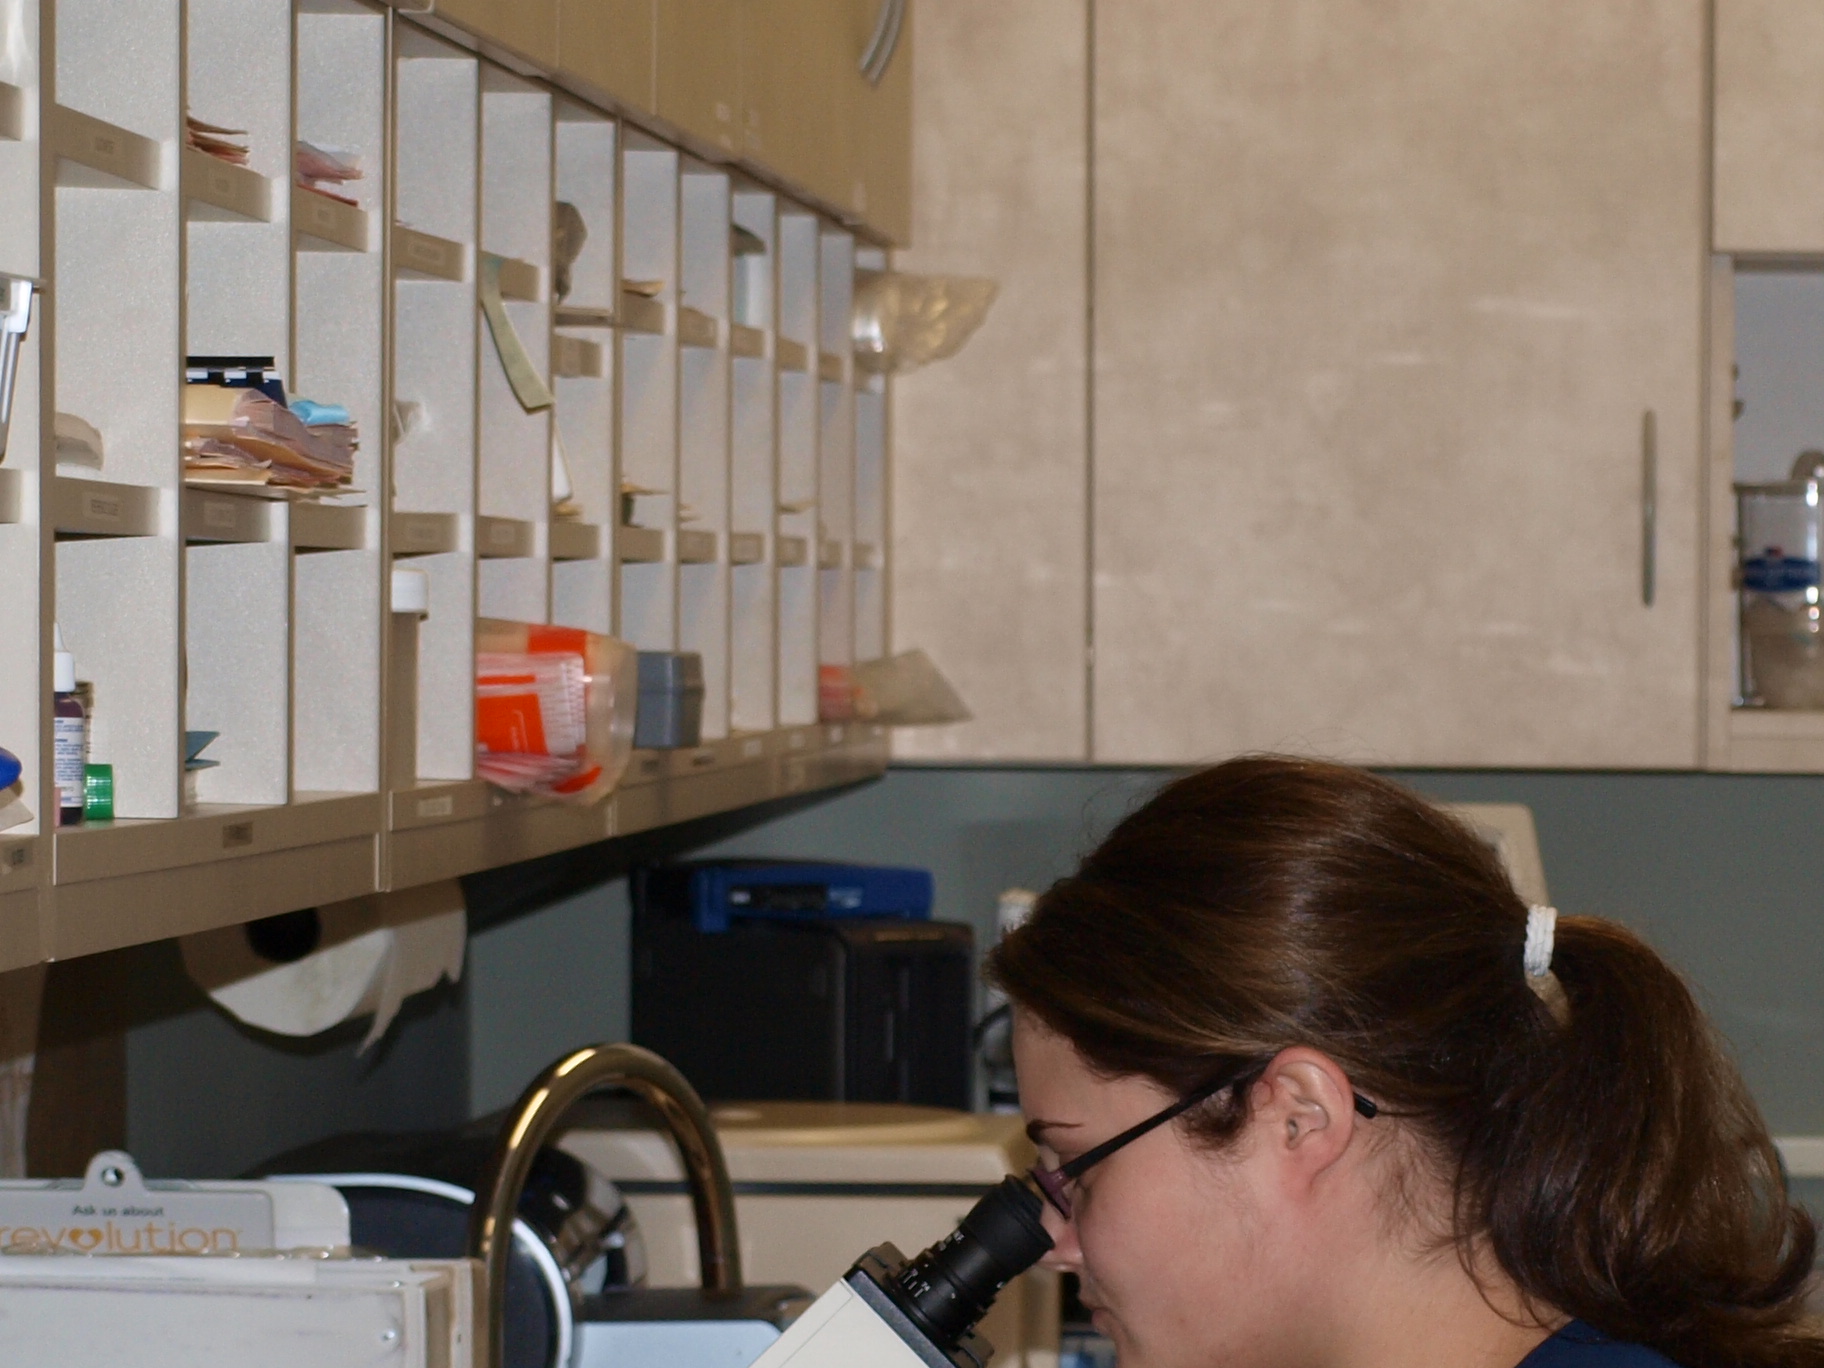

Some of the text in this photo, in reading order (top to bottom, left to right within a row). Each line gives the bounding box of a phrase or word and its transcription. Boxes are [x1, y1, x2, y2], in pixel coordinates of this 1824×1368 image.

[72, 1204, 164, 1216] Ask us about
